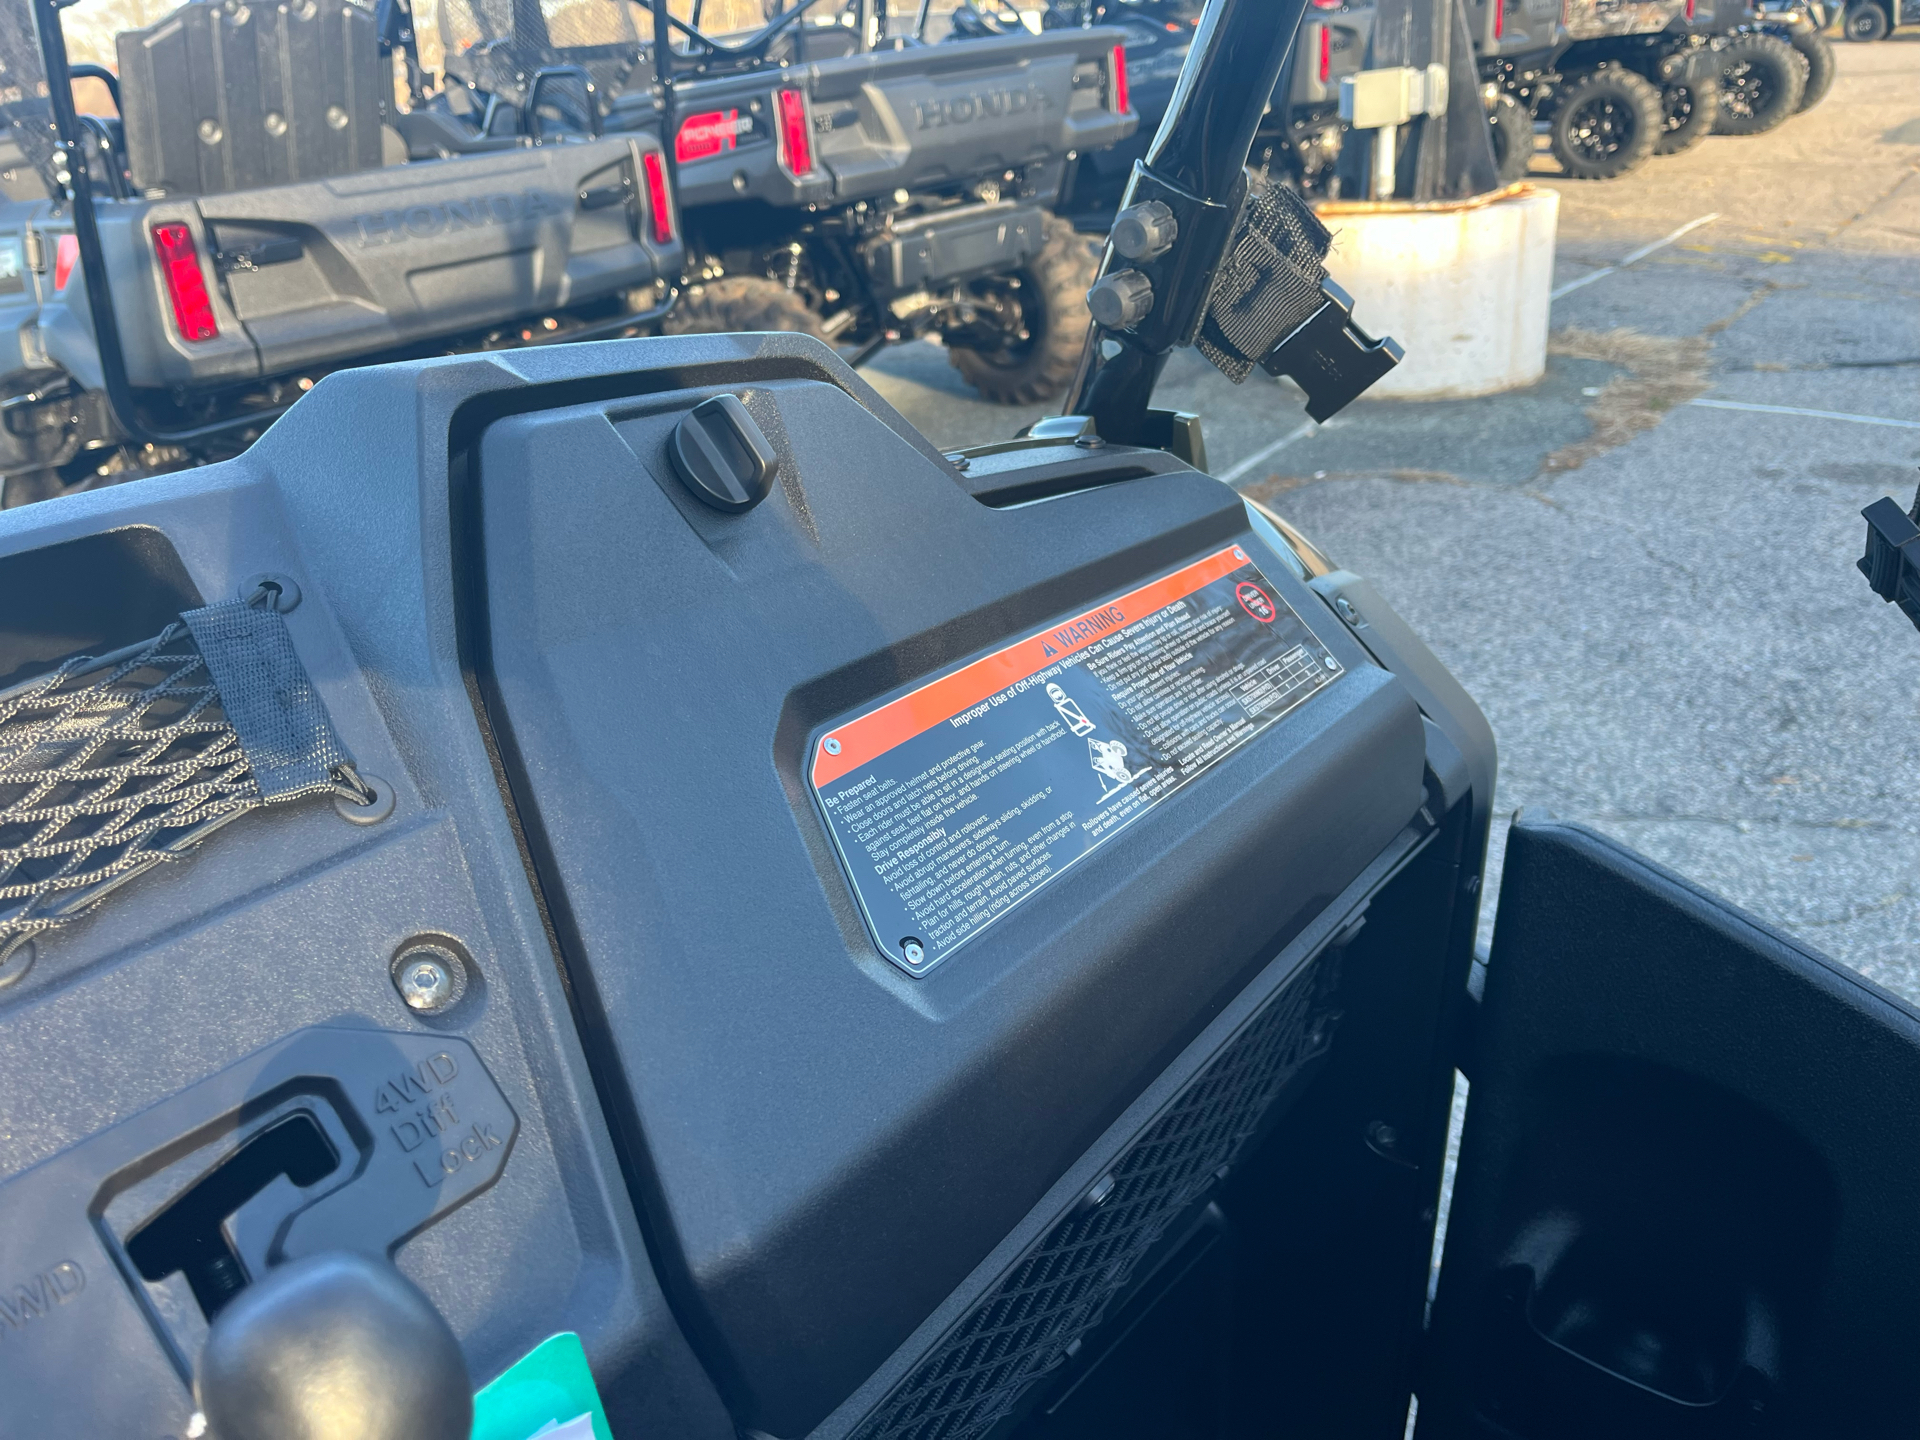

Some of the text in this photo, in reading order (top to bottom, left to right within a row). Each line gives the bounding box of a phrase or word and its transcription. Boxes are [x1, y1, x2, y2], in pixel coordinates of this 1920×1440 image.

[909, 80, 1055, 131] HONDA
[351, 186, 562, 249] HONDA
[1052, 604, 1126, 649] WARNING
[1242, 589, 1259, 602] DRIVER
[1248, 597, 1264, 609] UNDER
[1258, 606, 1268, 616] 16
[949, 702, 991, 727] Improper
[988, 694, 1008, 707] Use
[1006, 687, 1017, 698] of
[1014, 665, 1064, 693] Off-Highway
[1059, 650, 1090, 669] Vehicles
[1087, 644, 1104, 654] Can
[1101, 633, 1124, 647] Cause
[1121, 622, 1145, 637] Severe
[1142, 614, 1163, 626] Injury
[1166, 600, 1186, 614] Death
[1086, 612, 1190, 670] Be Sure Riders Pay Attention and Plan Ahead
[1265, 663, 1280, 674] Driver
[1282, 648, 1304, 664] Passenger
[1111, 686, 1134, 701] Require
[1131, 677, 1150, 690] Proper
[1147, 671, 1160, 680] Use
[1163, 662, 1177, 671] Your
[1174, 652, 1193, 665] Vehicle
[1239, 679, 1257, 692] Vehicle
[1178, 716, 1246, 765] Locate and Read Owner's Manual
[1180, 722, 1254, 775] Follow All Instructions and Warnings
[825, 775, 876, 807] Be Prepared
[836, 778, 898, 814] Fasten seat belts.
[843, 740, 986, 823] Wear an approved helmet and protective gear.
[850, 756, 980, 832] Close doors and latch nets before driving.
[857, 826, 878, 842] Each
[877, 818, 894, 831] rider
[893, 806, 912, 821] must
[910, 802, 921, 811] be
[920, 793, 936, 805] able
[934, 789, 943, 797] to
[942, 782, 952, 792] sit
[962, 757, 996, 780] designated
[994, 746, 1017, 761] seating
[1015, 734, 1036, 751] position
[1035, 726, 1047, 737] with
[1045, 719, 1060, 731] back
[1081, 766, 1173, 831] Rollovers have caused severe injuries
[1091, 776, 1176, 837] and death, even on flat, open areas.
[871, 793, 979, 861] Stay completely inside the vehicle.
[874, 827, 947, 874] Drive Responsibly
[882, 814, 989, 884] Avoid loss of control and rollovers:
[892, 873, 915, 891] Avoid
[914, 859, 937, 878] abrupt
[935, 838, 974, 864] maneuvers,
[972, 819, 1001, 840] sideways
[1000, 807, 1022, 822] sliding,
[1020, 791, 1046, 809] skidding,
[899, 835, 999, 901] fishtailing, and never do donuts.
[907, 895, 927, 910] Slow
[924, 882, 945, 898] down
[943, 868, 966, 886] before
[965, 852, 993, 872] entering
[994, 840, 1011, 851] turn.
[914, 902, 936, 920] Avoid
[933, 891, 952, 907] hard
[950, 867, 989, 896] acceleration
[988, 856, 1006, 870] when
[1003, 842, 1029, 859] turning,
[1027, 831, 1043, 844] even
[1040, 822, 1056, 834] from
[1059, 811, 1073, 822] stop.
[921, 915, 940, 929] Plan
[937, 908, 949, 918] for
[947, 898, 966, 911] hills,
[964, 883, 984, 901] rough
[981, 870, 1006, 888] terrain,
[1004, 861, 1020, 873] ruts,
[1018, 850, 1031, 863] and
[1030, 841, 1047, 855] other
[1045, 825, 1070, 844] changes
[935, 864, 1052, 949] Avoid side hilling (riding across slopes).
[375, 1052, 459, 1115] 4WD
[389, 1091, 461, 1154] Diff
[412, 1121, 503, 1189] Lock
[0, 1259, 87, 1333] WD
